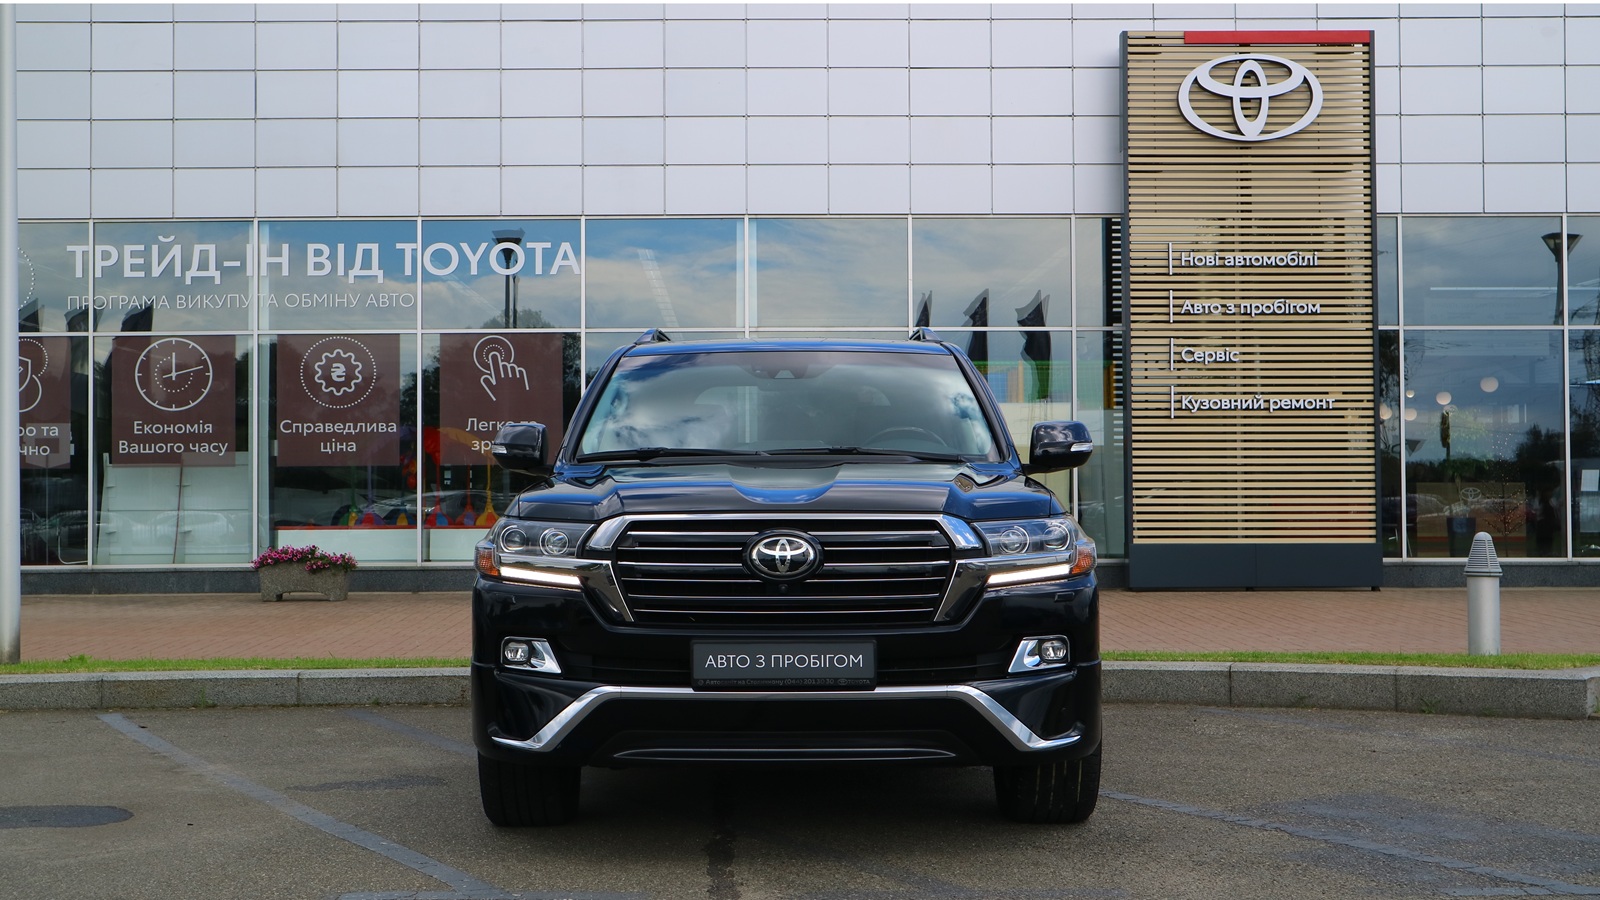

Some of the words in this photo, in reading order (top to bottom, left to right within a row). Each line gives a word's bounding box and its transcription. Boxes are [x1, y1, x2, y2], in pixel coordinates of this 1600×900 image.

[66, 235, 290, 285] ТРЕЙД-ІН
[306, 243, 384, 284] ВІД
[396, 242, 581, 276] TOYOTA
[1181, 251, 1220, 266] Нові
[1224, 251, 1319, 266] автомобілі
[67, 295, 170, 310] ПРОГРАМА
[177, 294, 253, 309] ВИКУПУ
[284, 293, 361, 309] ОБМІНУ
[366, 293, 415, 308] АВТО
[1181, 300, 1222, 314] Авто
[1226, 303, 1235, 314] з
[1240, 299, 1321, 318] пробігом
[1181, 347, 1240, 366] Сервіс
[1181, 395, 1264, 413] Кузовний
[1269, 398, 1336, 413] ремонт
[41, 426, 59, 436] та
[133, 420, 213, 434] Економія
[280, 419, 397, 436] Справедлива
[466, 418, 514, 431] Легк
[118, 440, 185, 454] Вашого
[189, 443, 228, 456] часу
[320, 438, 357, 454] ціна
[705, 655, 750, 668] АВТО
[771, 655, 863, 668] ПРОБІГОМ
